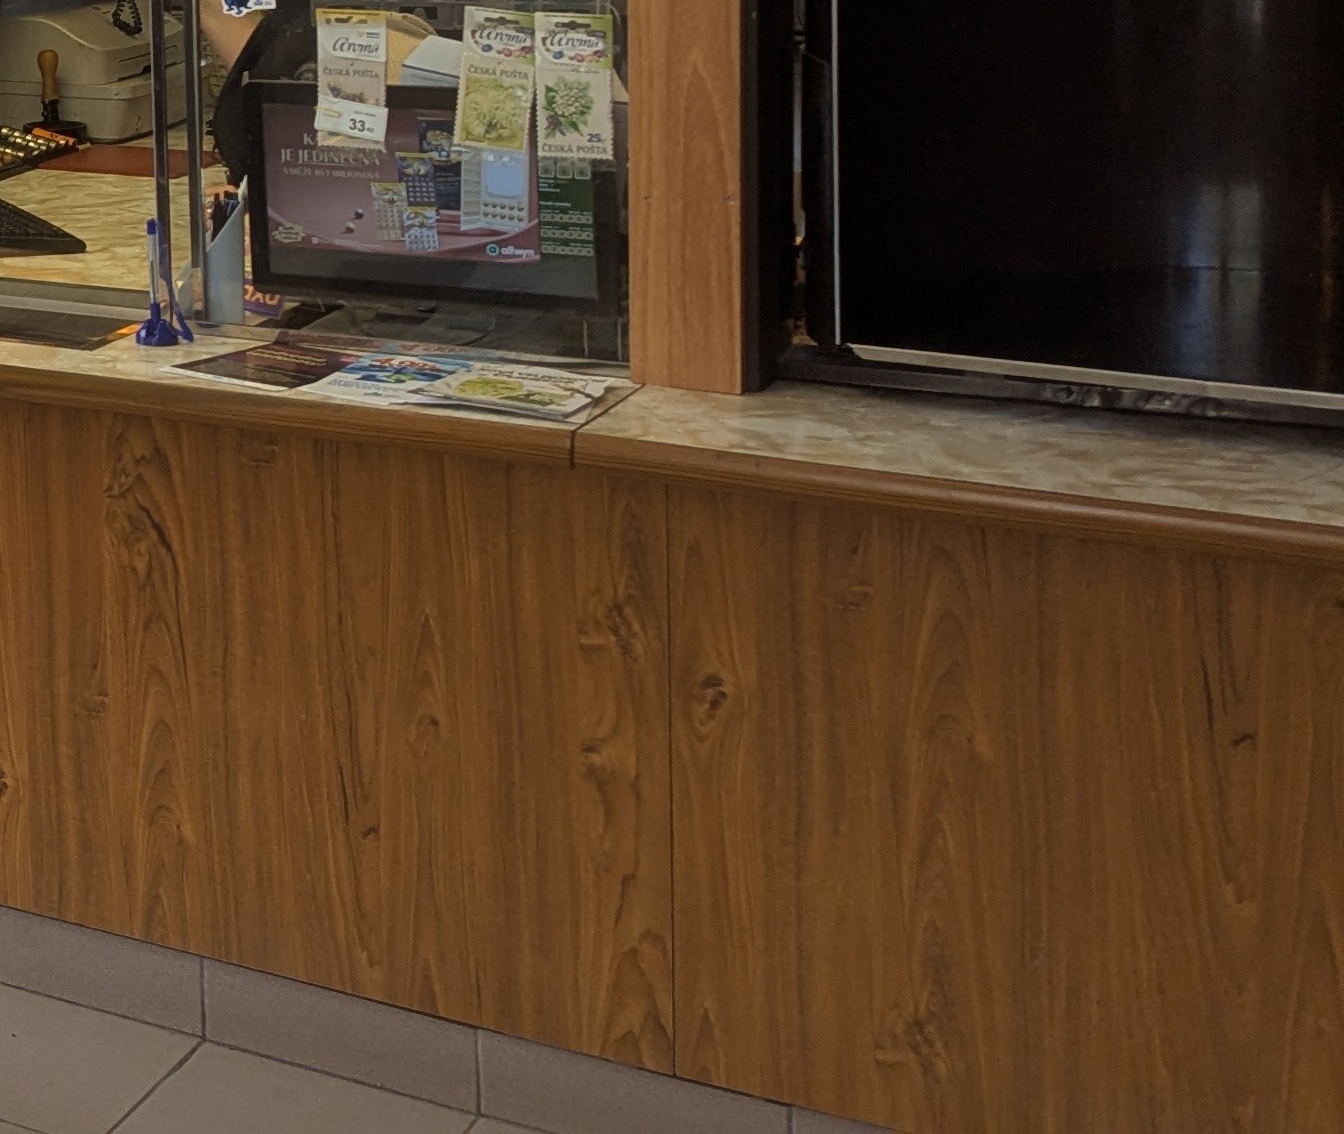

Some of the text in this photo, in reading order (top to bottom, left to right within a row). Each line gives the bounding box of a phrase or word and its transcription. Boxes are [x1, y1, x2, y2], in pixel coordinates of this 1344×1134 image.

[323, 63, 379, 79] ČESKÁ POŠTA
[468, 64, 529, 80] ČESKÁ POŠTA
[348, 118, 366, 132] 33
[542, 140, 608, 155] ČESKÁ POŠTA
